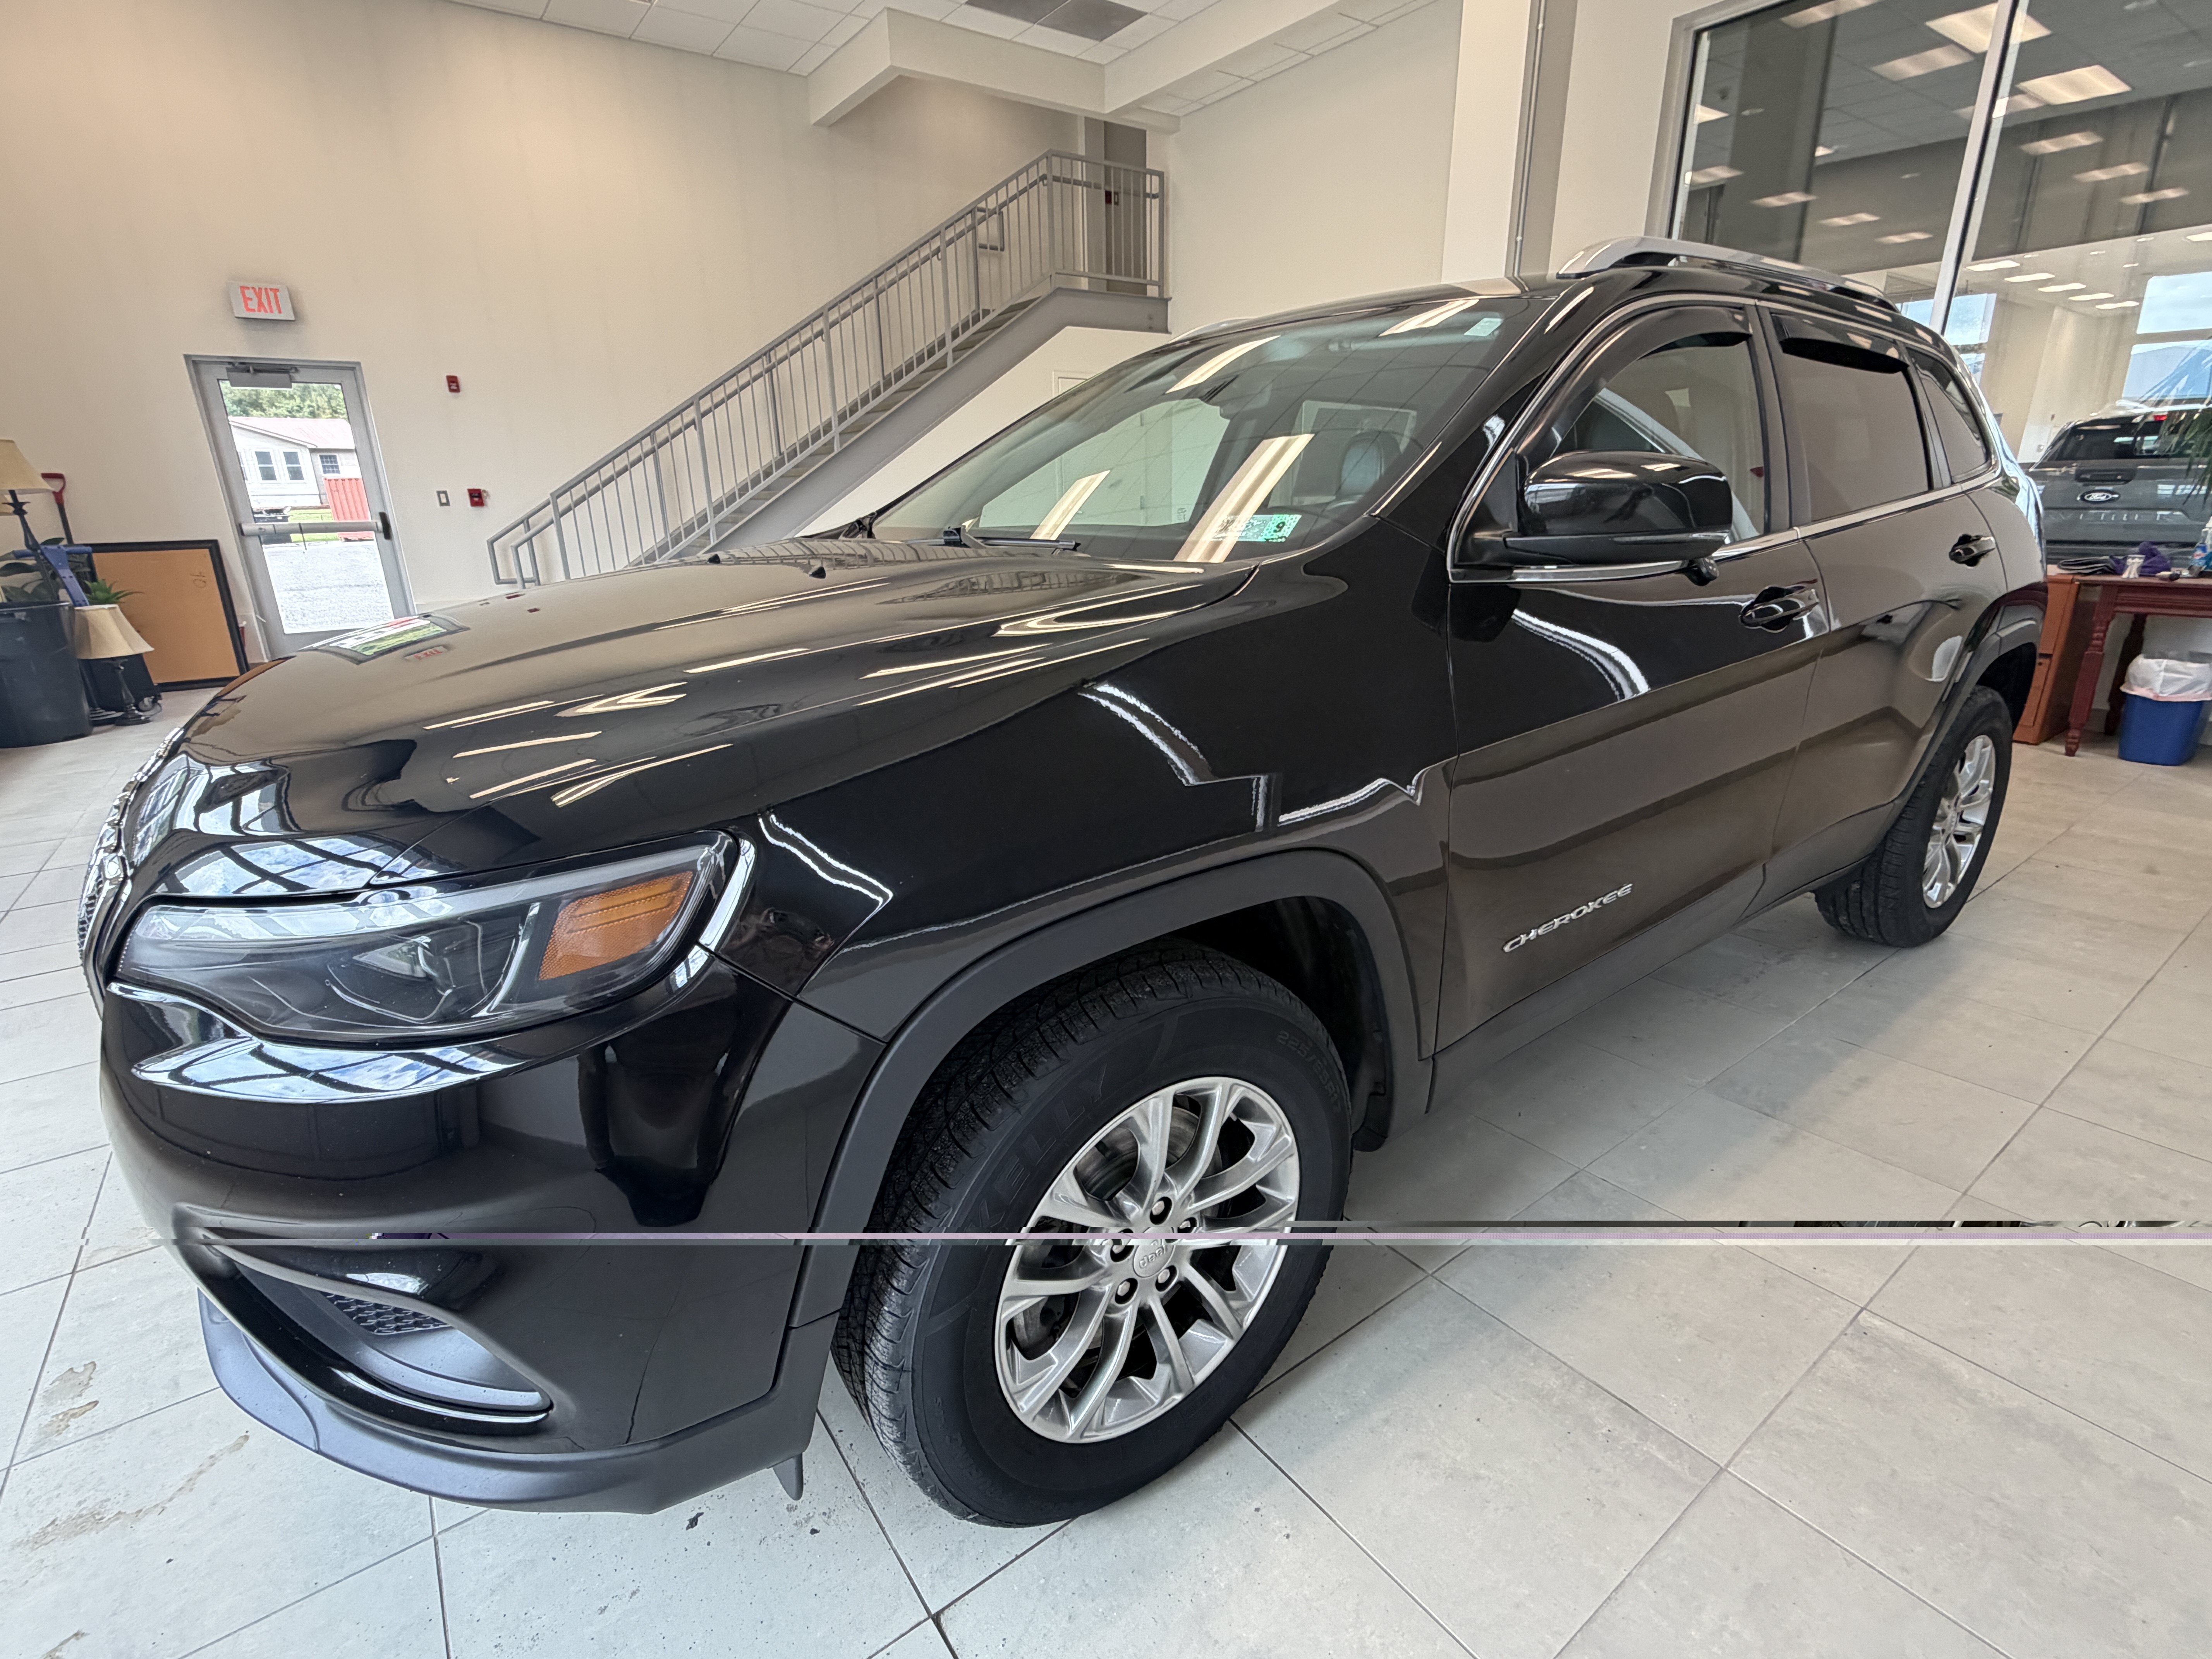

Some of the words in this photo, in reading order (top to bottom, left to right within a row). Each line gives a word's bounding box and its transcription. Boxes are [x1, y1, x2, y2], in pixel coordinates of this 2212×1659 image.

[239, 286, 282, 314] EXIT
[1273, 521, 1286, 533] 9
[1503, 883, 1633, 953] CHEROKEE
